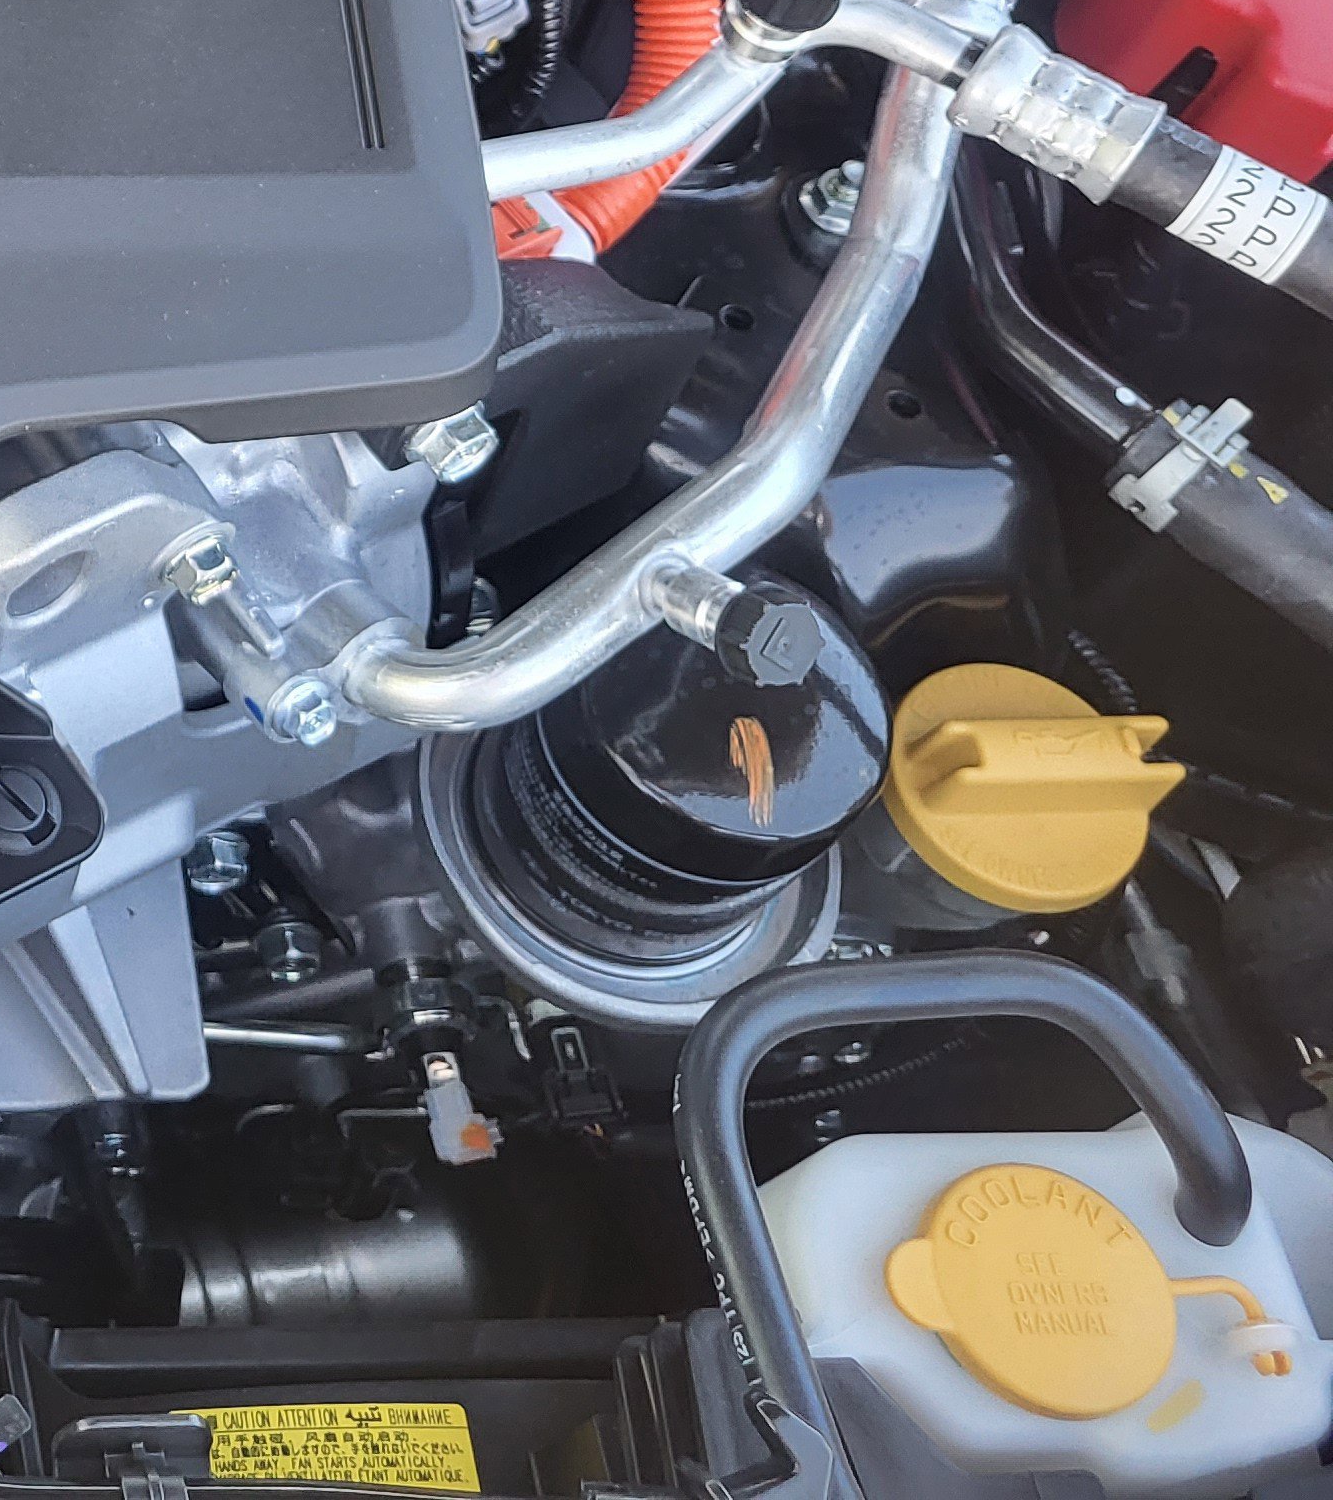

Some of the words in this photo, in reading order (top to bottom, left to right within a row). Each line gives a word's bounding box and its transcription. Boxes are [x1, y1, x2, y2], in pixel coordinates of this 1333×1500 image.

[1225, 178, 1256, 208] 2
[1263, 195, 1297, 219] P
[1205, 207, 1237, 236] 2
[1242, 224, 1278, 247] P
[944, 1175, 1133, 1248] COOLANT
[1015, 1251, 1067, 1277] SEE
[223, 1409, 271, 1429] CAUTION
[277, 1408, 338, 1428] ATTENTION
[387, 1408, 453, 1426] ВНИМАНИЕ
[215, 1459, 248, 1473] HANDS
[291, 1456, 312, 1470] FAN
[317, 1454, 357, 1469] STARTS
